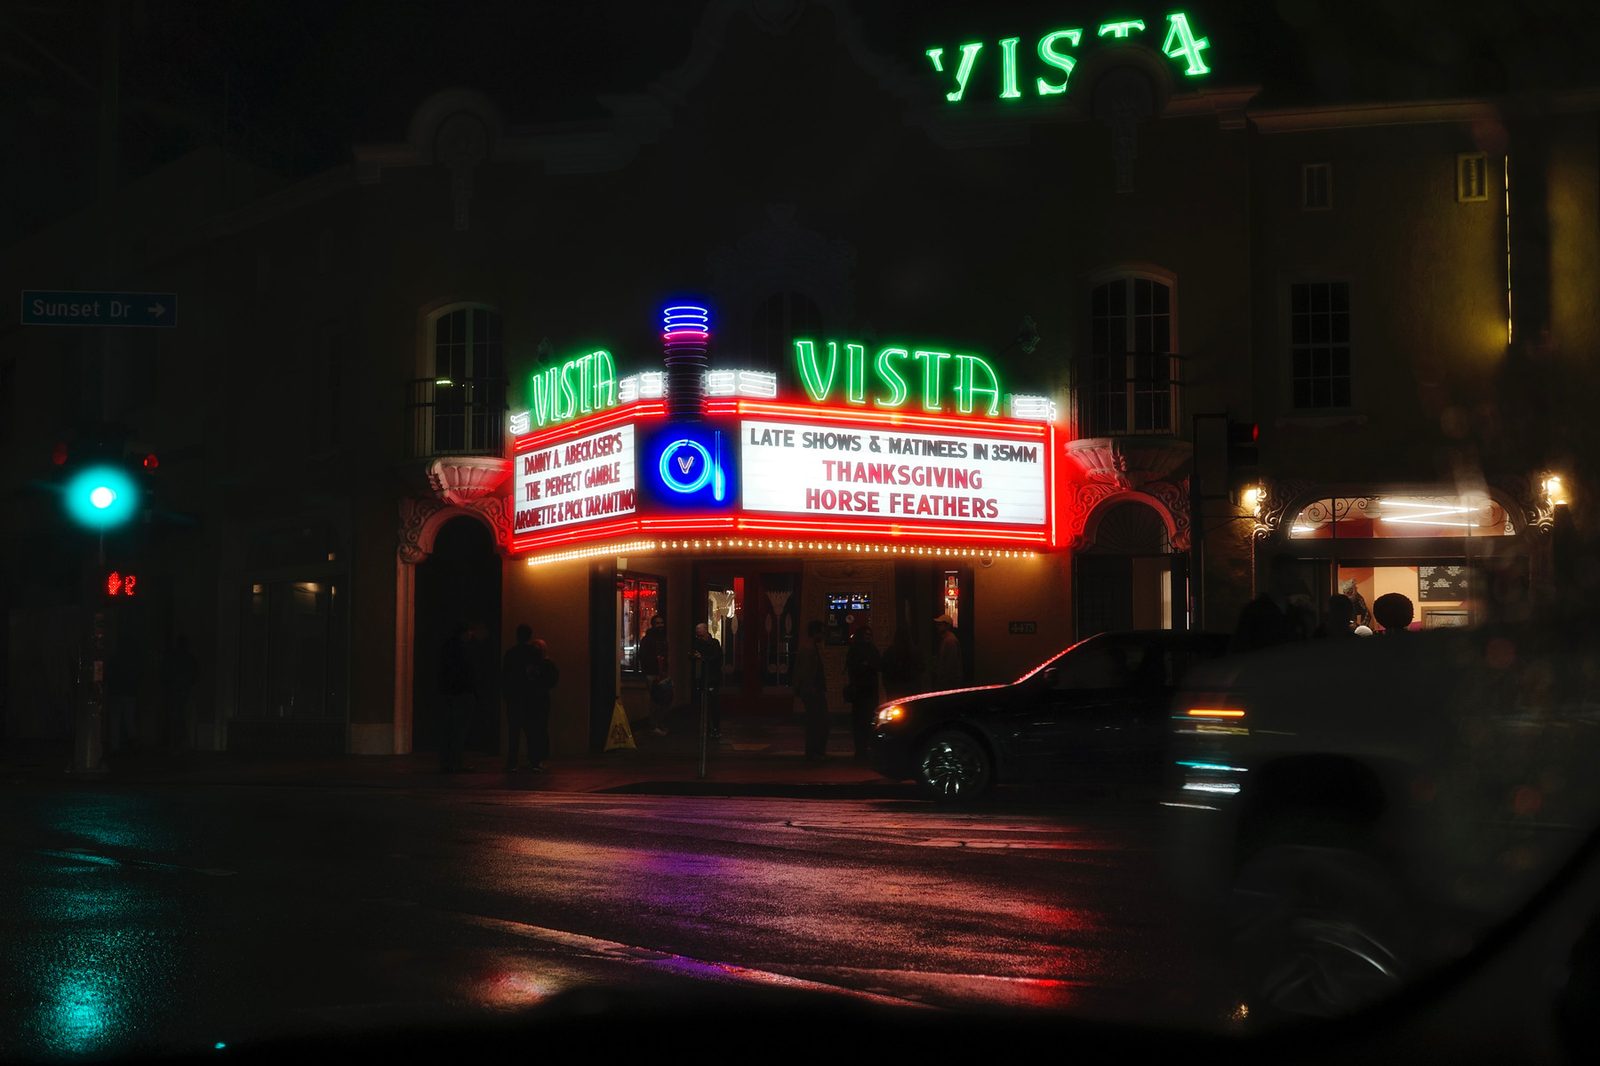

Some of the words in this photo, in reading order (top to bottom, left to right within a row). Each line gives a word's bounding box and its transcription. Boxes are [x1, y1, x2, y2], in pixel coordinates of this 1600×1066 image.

[31, 298, 101, 318] Sunset
[110, 299, 132, 319] Dr
[533, 350, 616, 427] VISTA
[794, 339, 1000, 416] VISTA
[524, 451, 551, 476] DANNY
[553, 449, 561, 469] A.
[565, 432, 623, 466] ABECKASER'S
[750, 427, 795, 448] LATE
[802, 431, 862, 452] SHOWS
[869, 435, 882, 453] &
[888, 436, 967, 459] MATINEES
[973, 443, 989, 461] IN
[991, 444, 1038, 464] 35MM
[525, 481, 541, 502] THE
[545, 471, 582, 498] PERFECT
[585, 462, 621, 489] GAMBLE
[678, 456, 694, 475] V
[822, 459, 983, 490] THANKSGIVING
[515, 503, 556, 530] ARQUETTE
[557, 502, 564, 522] &
[565, 498, 583, 520] PICK
[585, 488, 636, 517] TARANTINO
[806, 488, 880, 513] HORSE
[890, 492, 999, 519] FEATHERS
